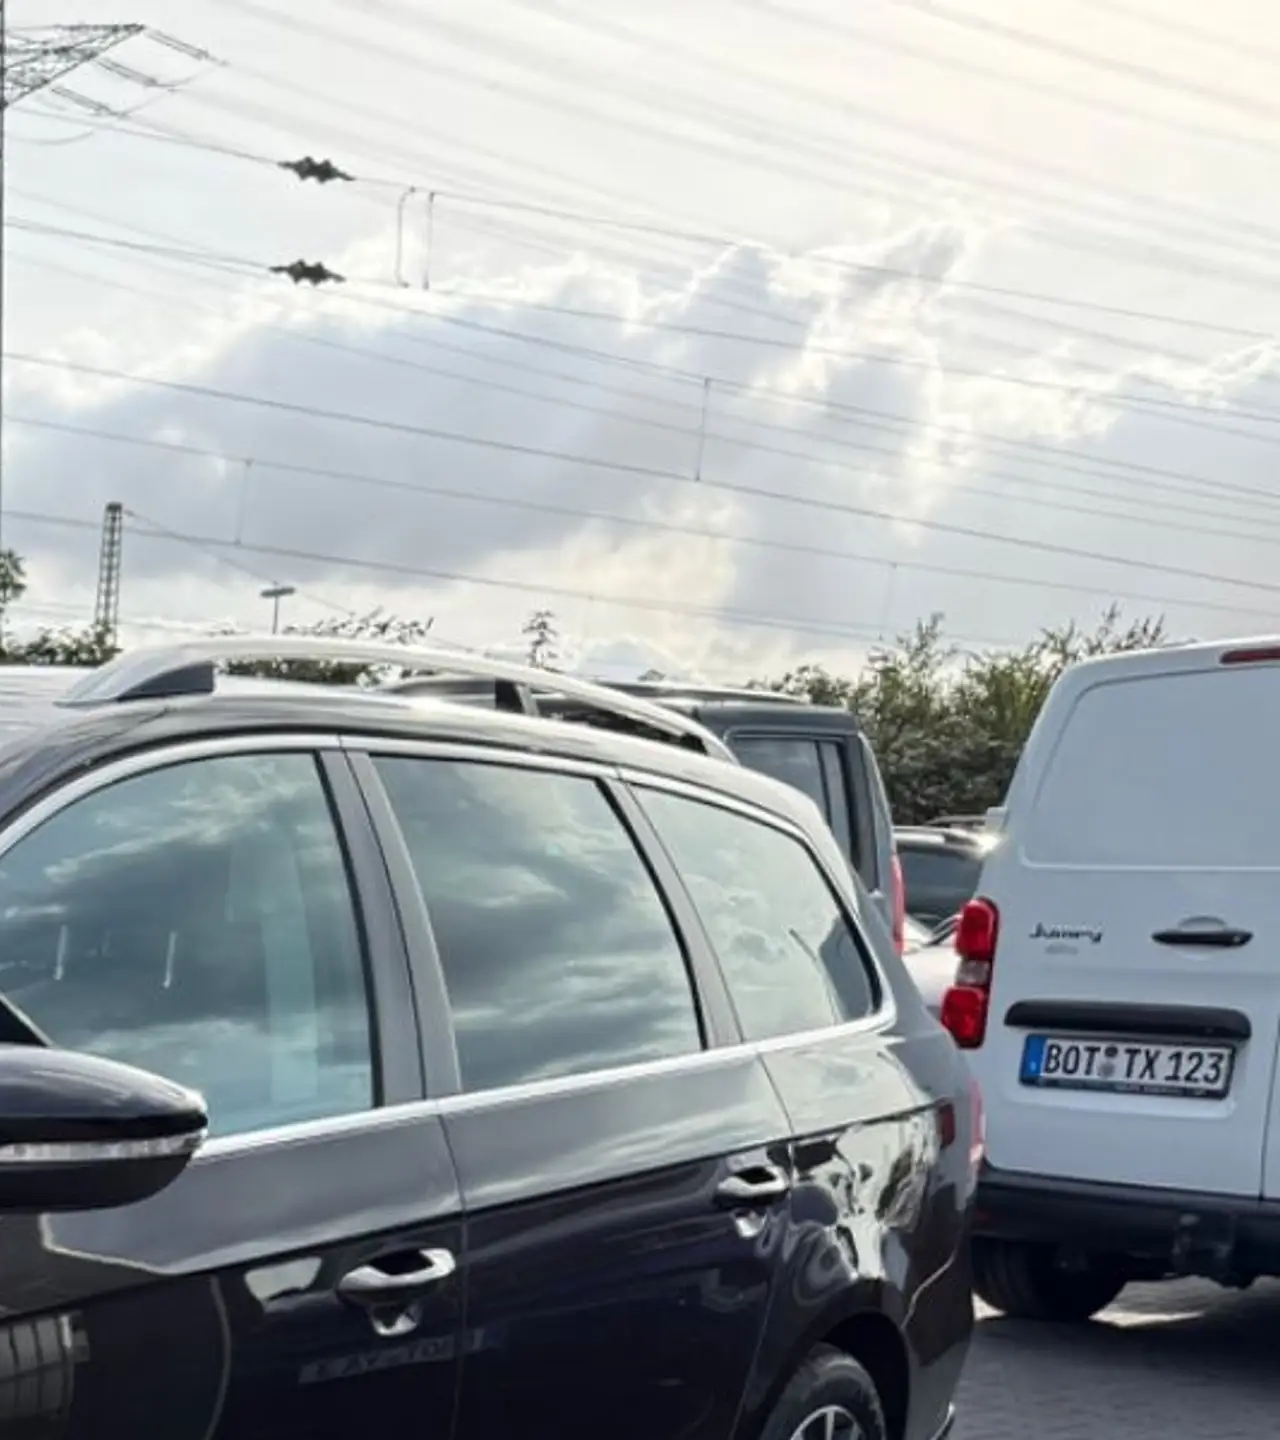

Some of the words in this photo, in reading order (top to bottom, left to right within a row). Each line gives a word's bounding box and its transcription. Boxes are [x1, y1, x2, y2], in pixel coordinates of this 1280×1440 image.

[1043, 1044, 1101, 1076] BOT
[1123, 1047, 1162, 1082] TX
[1164, 1051, 1225, 1084] 123
